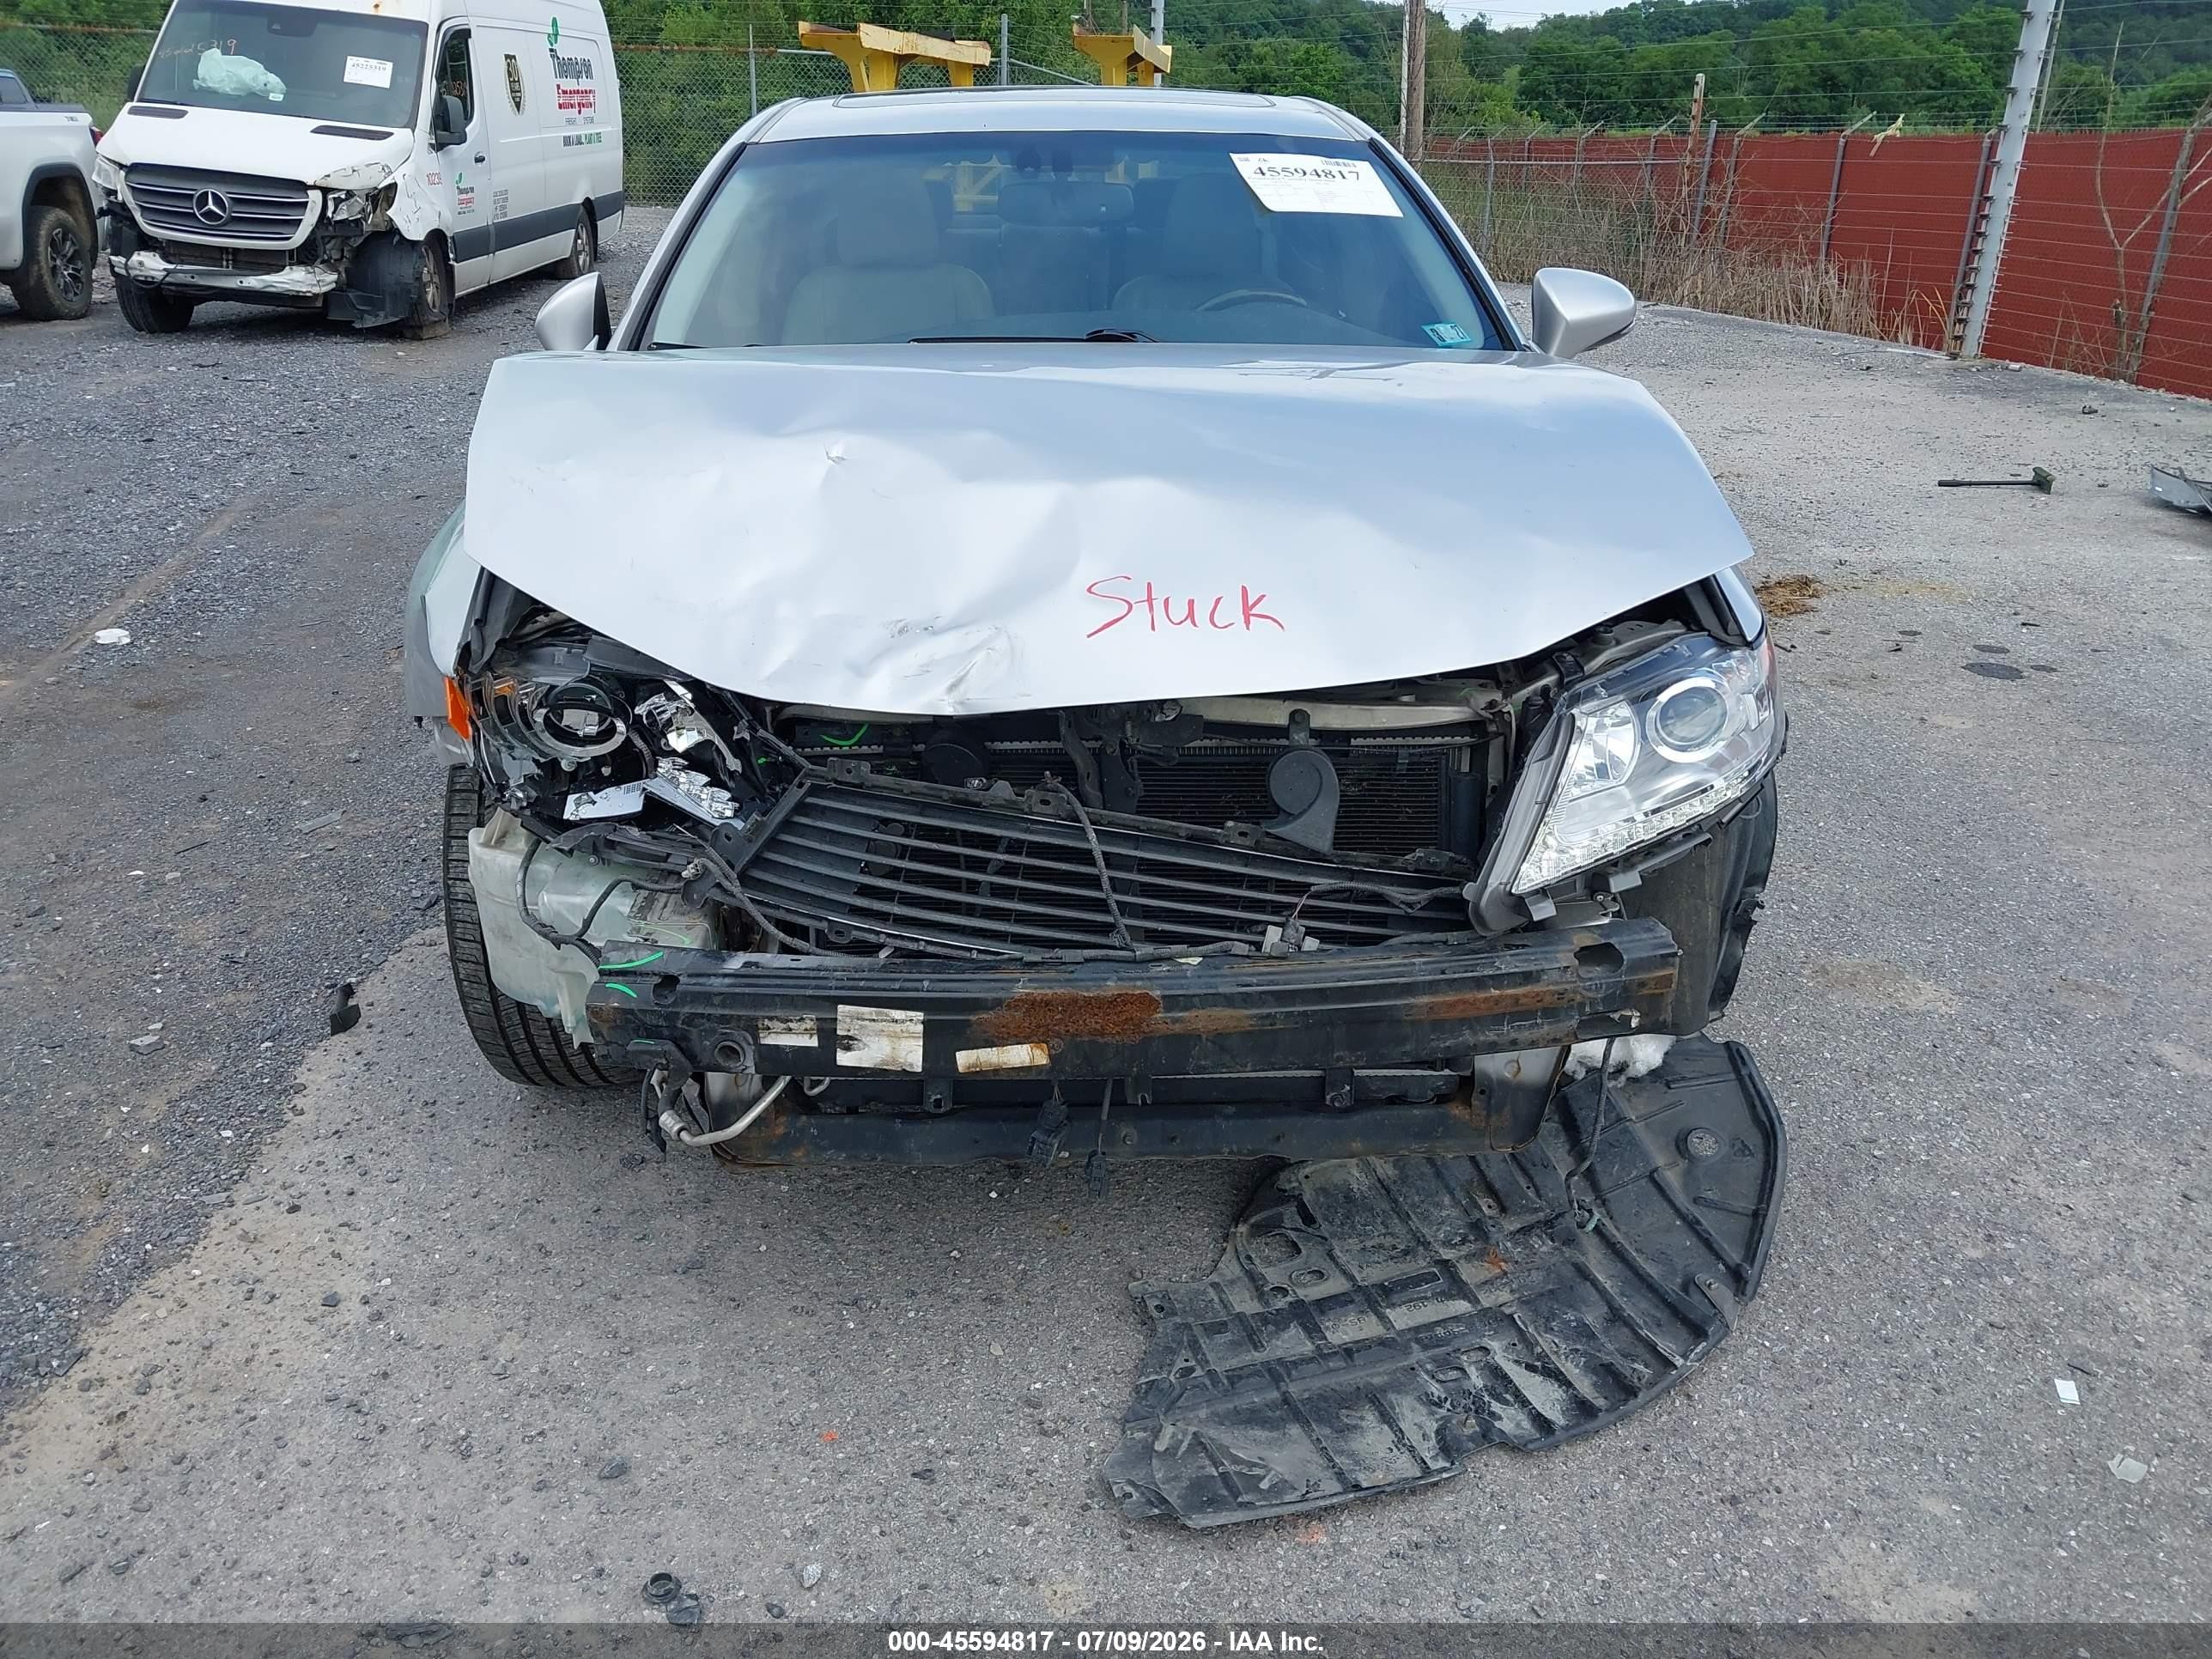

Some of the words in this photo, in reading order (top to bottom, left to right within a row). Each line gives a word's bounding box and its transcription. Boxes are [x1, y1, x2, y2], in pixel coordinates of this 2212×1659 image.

[507, 58, 519, 82] 30
[549, 48, 594, 85] Thompson
[556, 83, 596, 115] Emergency
[1253, 166, 1360, 181] 45594817
[1085, 575, 1285, 639] Stuck
